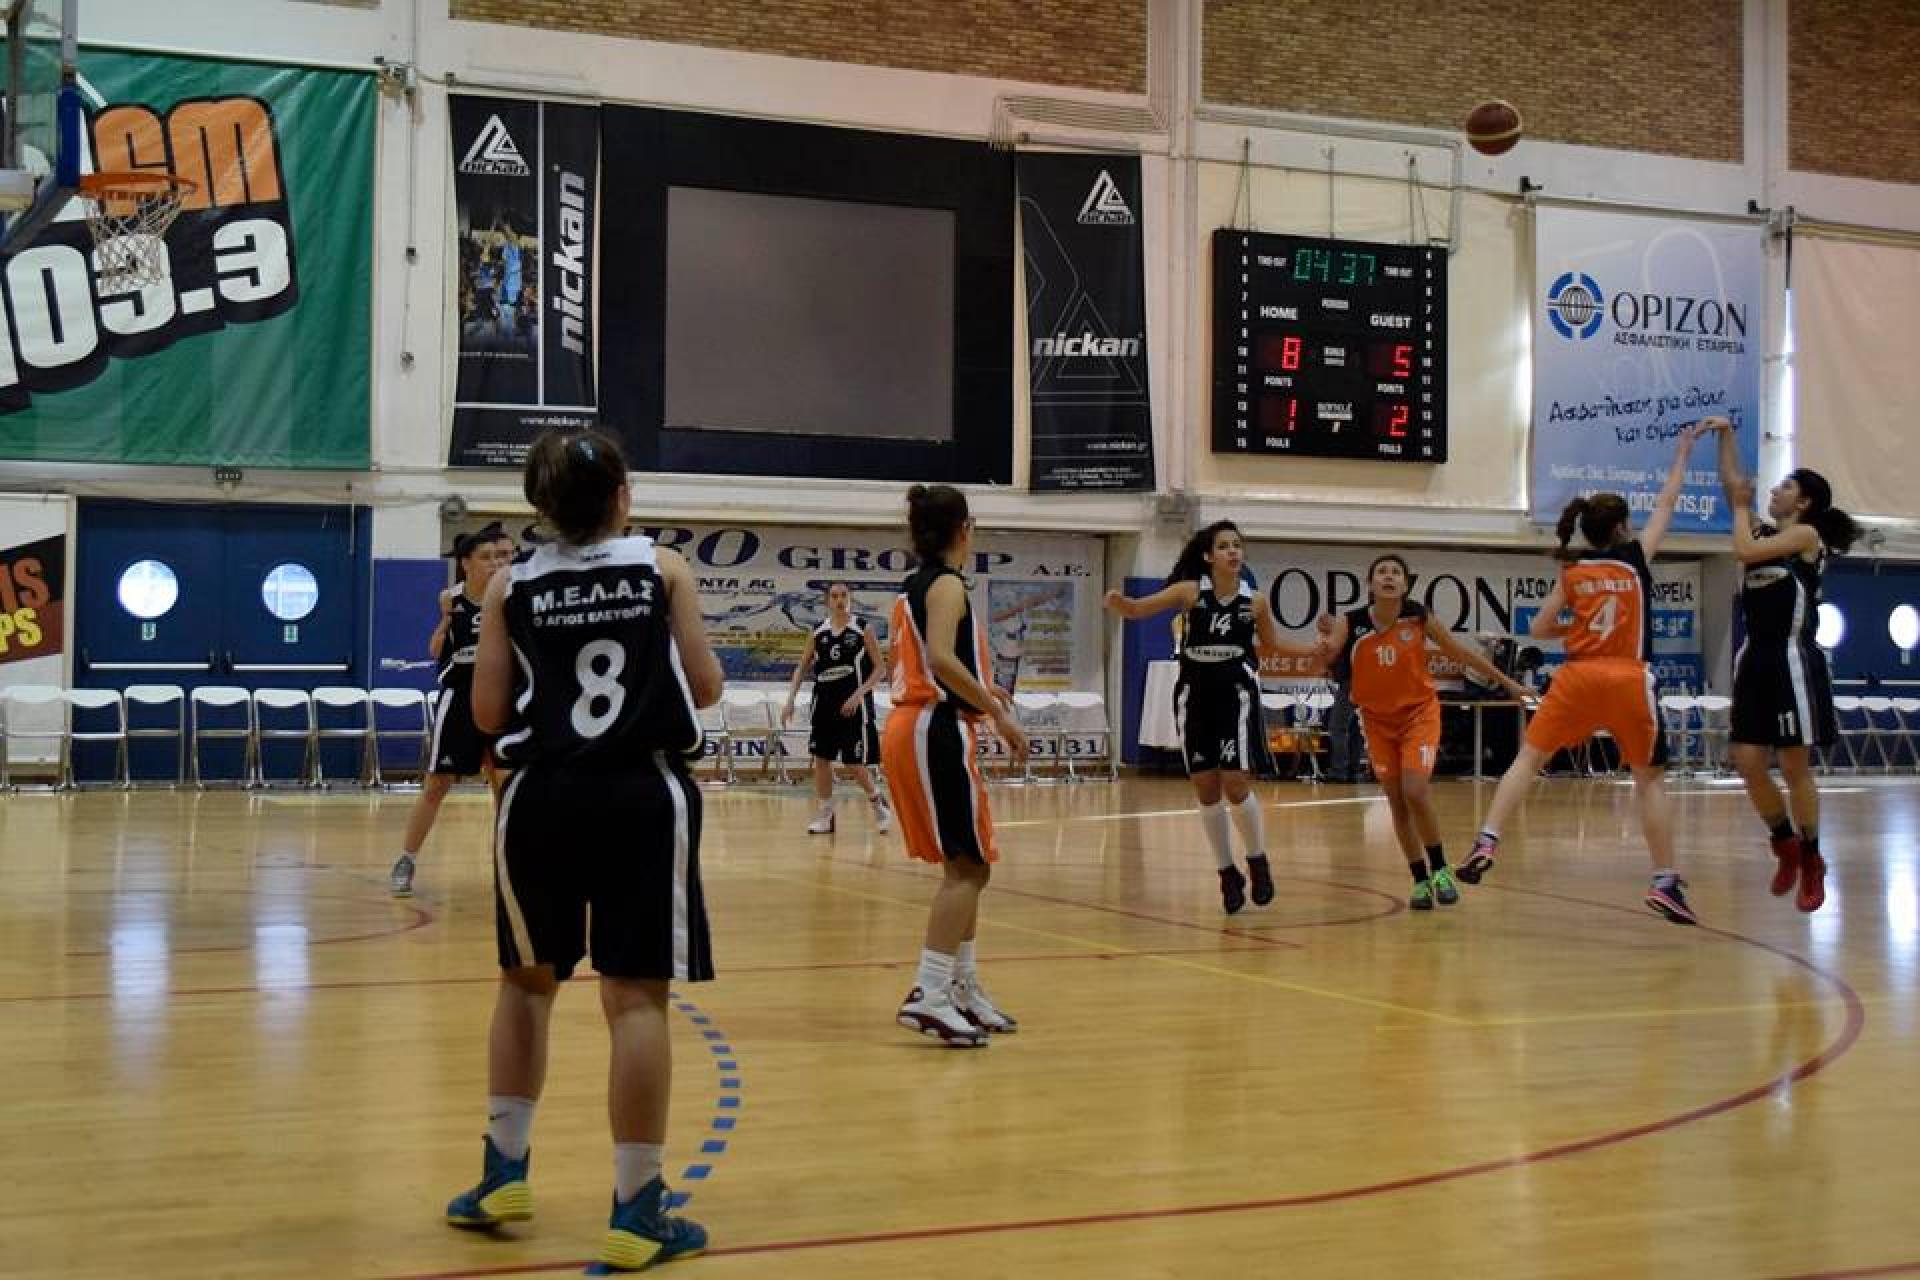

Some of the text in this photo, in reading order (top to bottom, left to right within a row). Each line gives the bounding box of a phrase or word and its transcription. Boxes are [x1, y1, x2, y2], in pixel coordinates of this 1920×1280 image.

[552, 170, 585, 355] nickan
[1260, 306, 1296, 320] HOME
[1370, 314, 1411, 328] GUEST
[1611, 291, 1747, 336] ΟΡΙΖΩΝ
[1034, 331, 1140, 357] nickan
[1282, 337, 1301, 370] 8
[1393, 346, 1413, 377] 5
[1288, 399, 1298, 431] 1
[1390, 405, 1410, 437] 2
[778, 546, 1014, 576] GROP
[1209, 611, 1232, 636] 14
[1588, 594, 1622, 643] 4
[1376, 644, 1398, 668] 10
[571, 639, 627, 739] 8
[1777, 710, 1796, 738] 11
